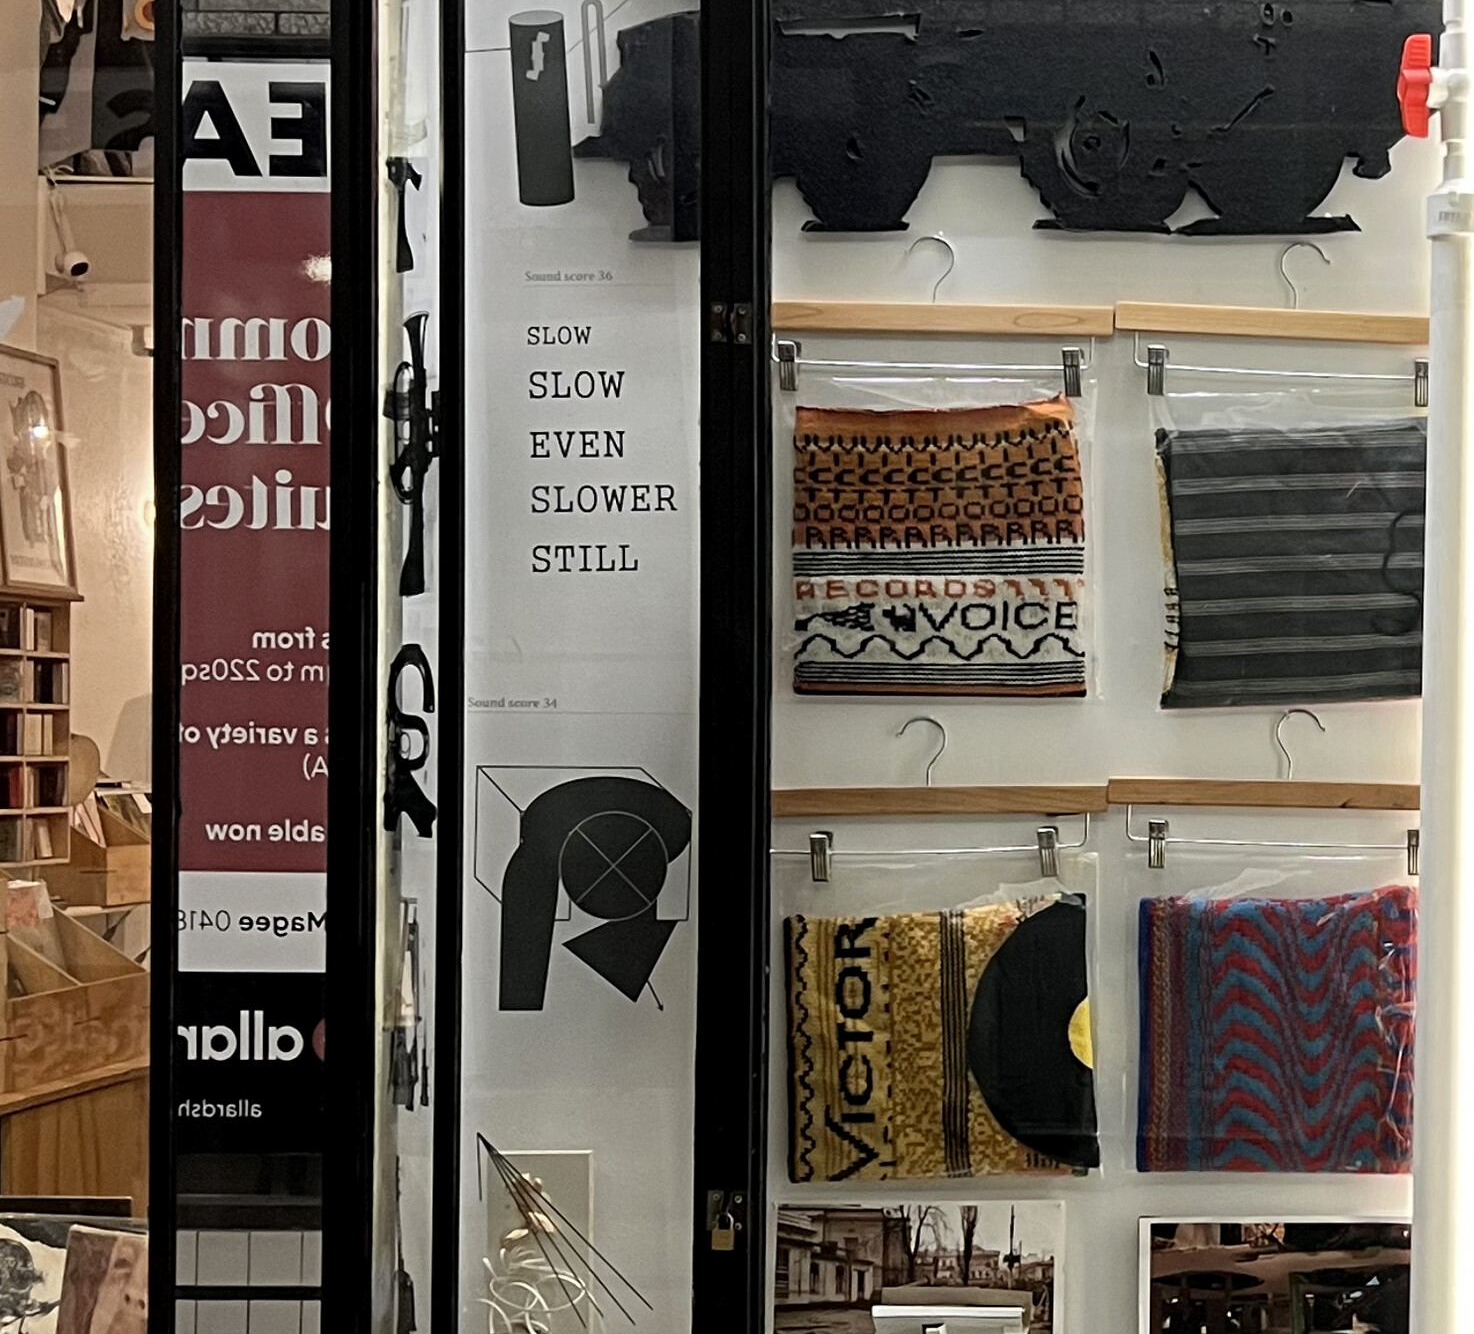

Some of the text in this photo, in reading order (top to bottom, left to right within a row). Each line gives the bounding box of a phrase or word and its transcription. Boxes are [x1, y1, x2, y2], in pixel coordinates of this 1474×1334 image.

[525, 270, 613, 282] Sound score 36
[527, 325, 592, 346] SLOW
[528, 370, 626, 399] SLOW
[529, 430, 626, 459] EVEN
[530, 483, 678, 514] SLOWER
[531, 543, 640, 574] STILL
[795, 578, 996, 600] RECORDS
[919, 600, 1077, 632] VOICE
[467, 696, 506, 708] Sound
[508, 699, 540, 708] score
[825, 916, 881, 1181] VICTOR
